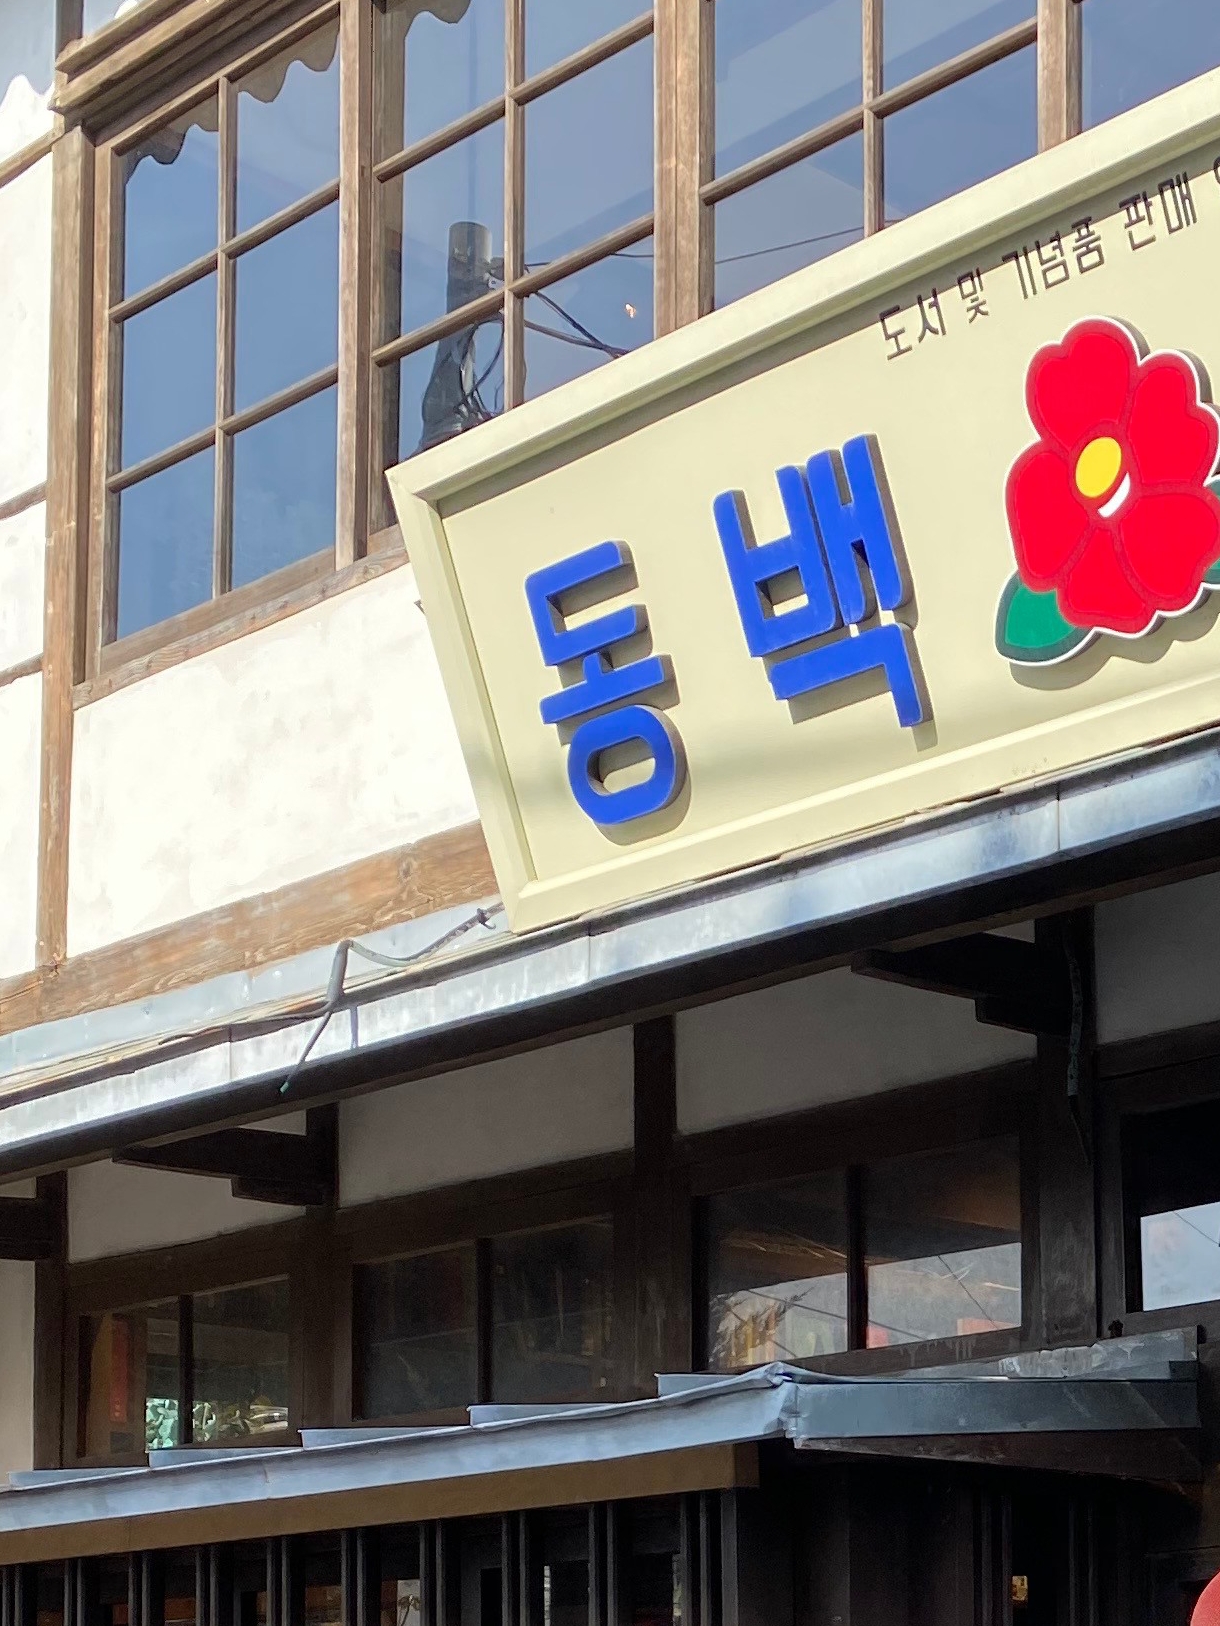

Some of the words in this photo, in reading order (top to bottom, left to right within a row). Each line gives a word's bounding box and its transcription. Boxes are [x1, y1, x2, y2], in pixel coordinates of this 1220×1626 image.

[879, 287, 947, 360] 도서
[956, 267, 989, 324] 및
[1001, 216, 1105, 300] 기념품
[1118, 171, 1198, 251] 판매
[526, 437, 926, 827] 동백
